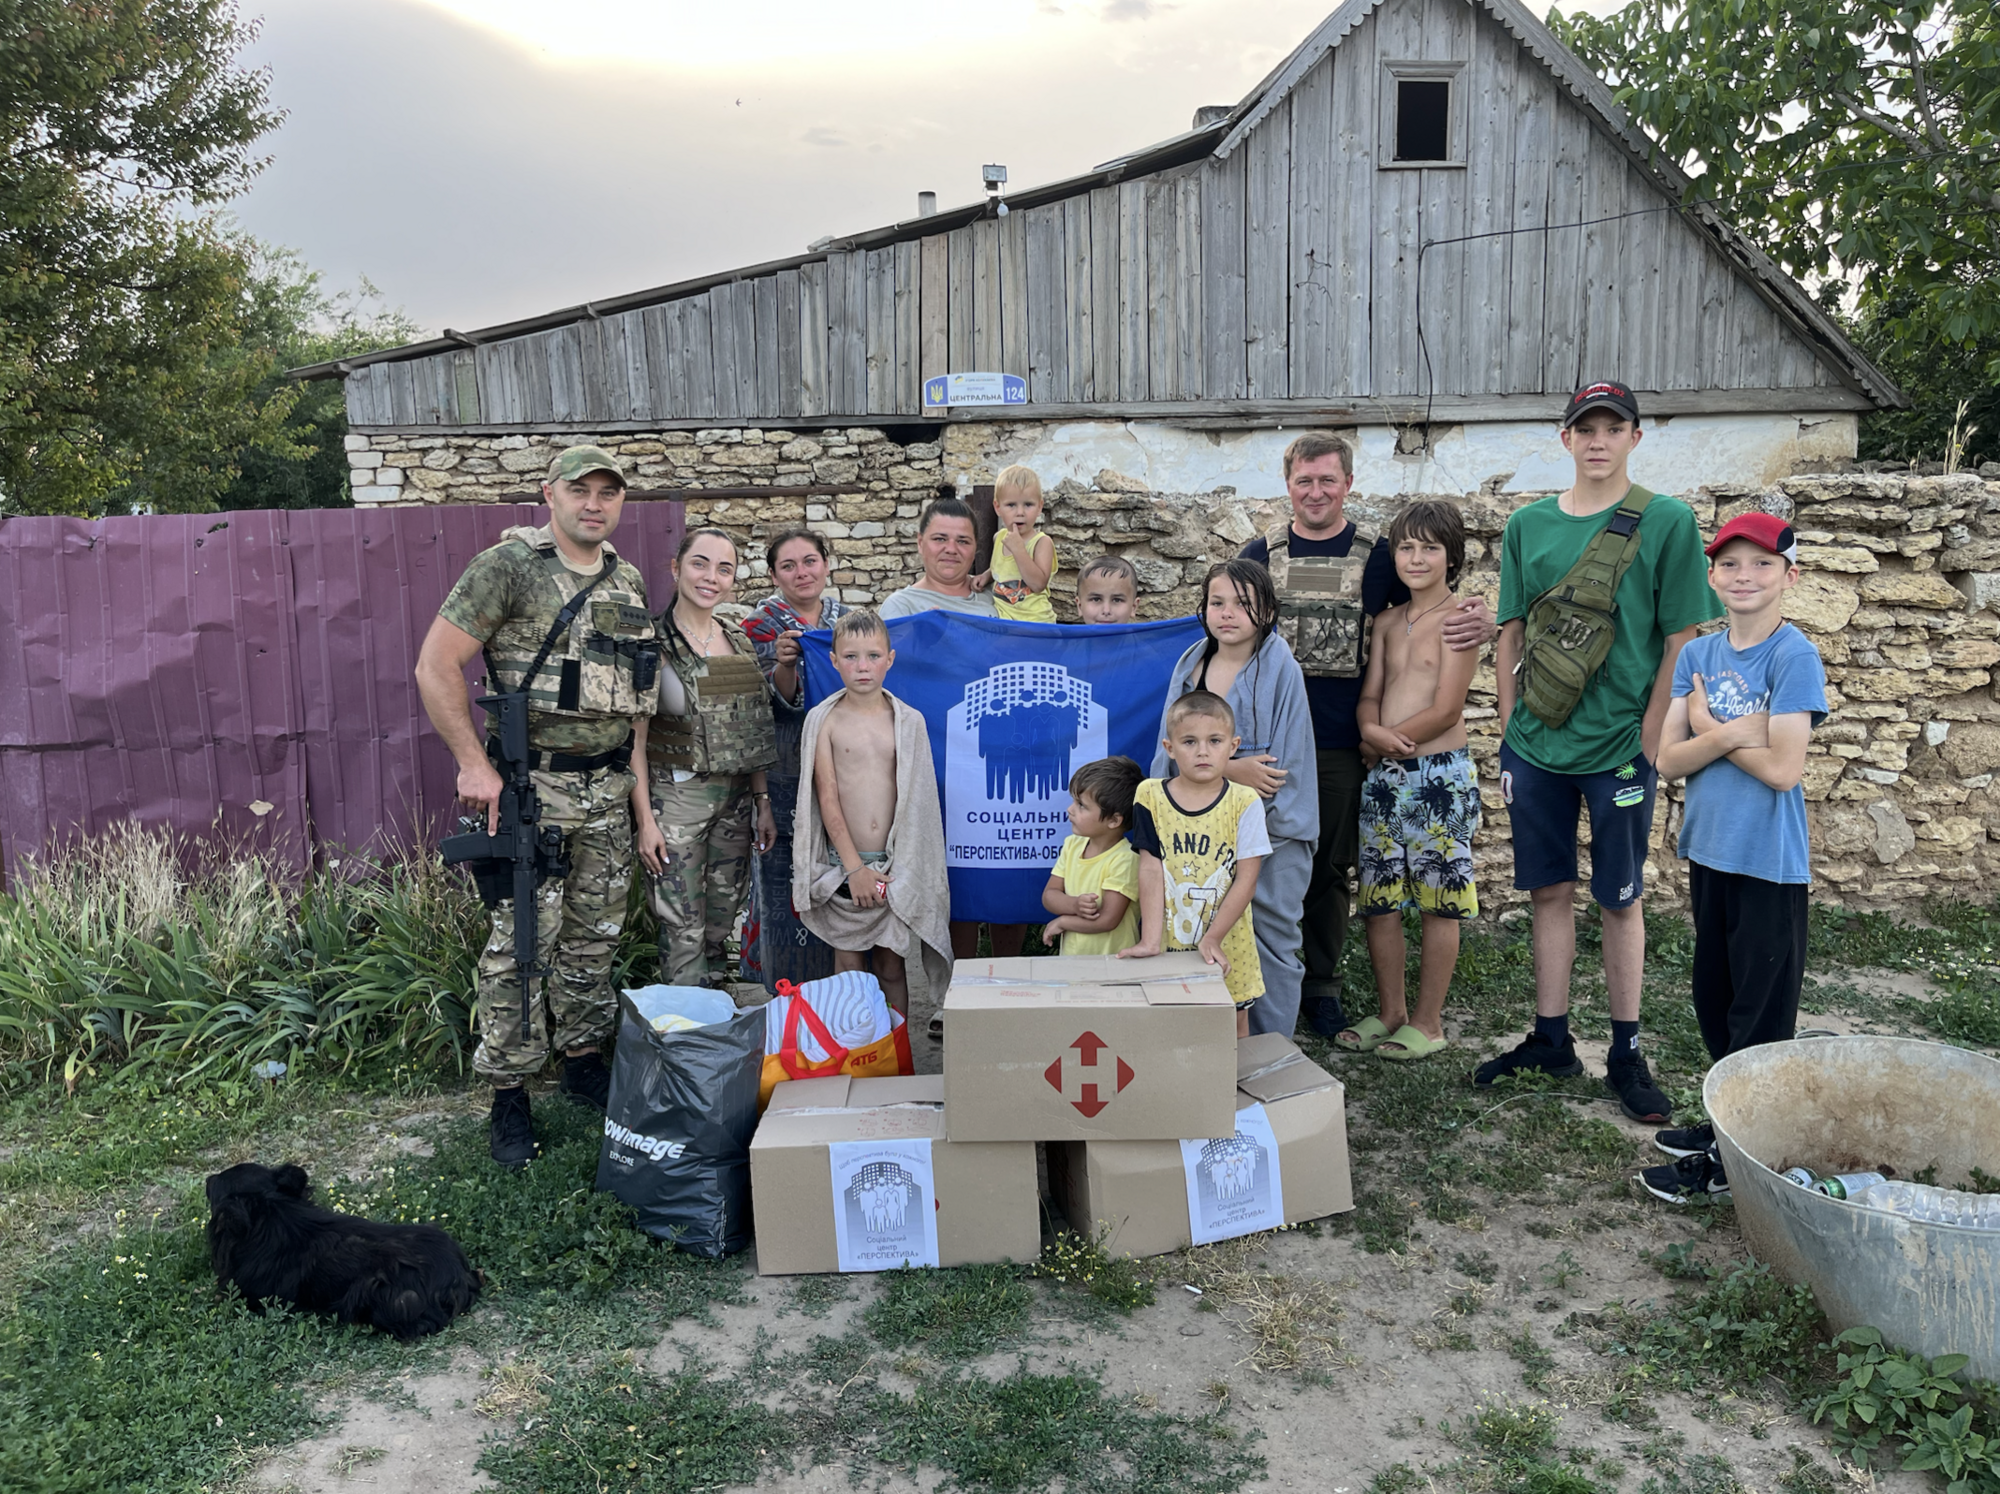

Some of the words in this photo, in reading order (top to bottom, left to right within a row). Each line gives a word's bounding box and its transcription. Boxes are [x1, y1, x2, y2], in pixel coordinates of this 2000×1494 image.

[950, 394, 1002, 402] ЦЕНТРАЛЬНА
[1006, 387, 1024, 400] 124
[997, 827, 1057, 842] ЦЕНТР
[1173, 832, 1210, 856] AND
[609, 1150, 635, 1167] EXPLORE
[1209, 1209, 1265, 1229] «ПЕРСПЕКТИВА»
[866, 1234, 907, 1244] Соціальний
[857, 1250, 919, 1260] «ПЕРСПЕКТИВА»
